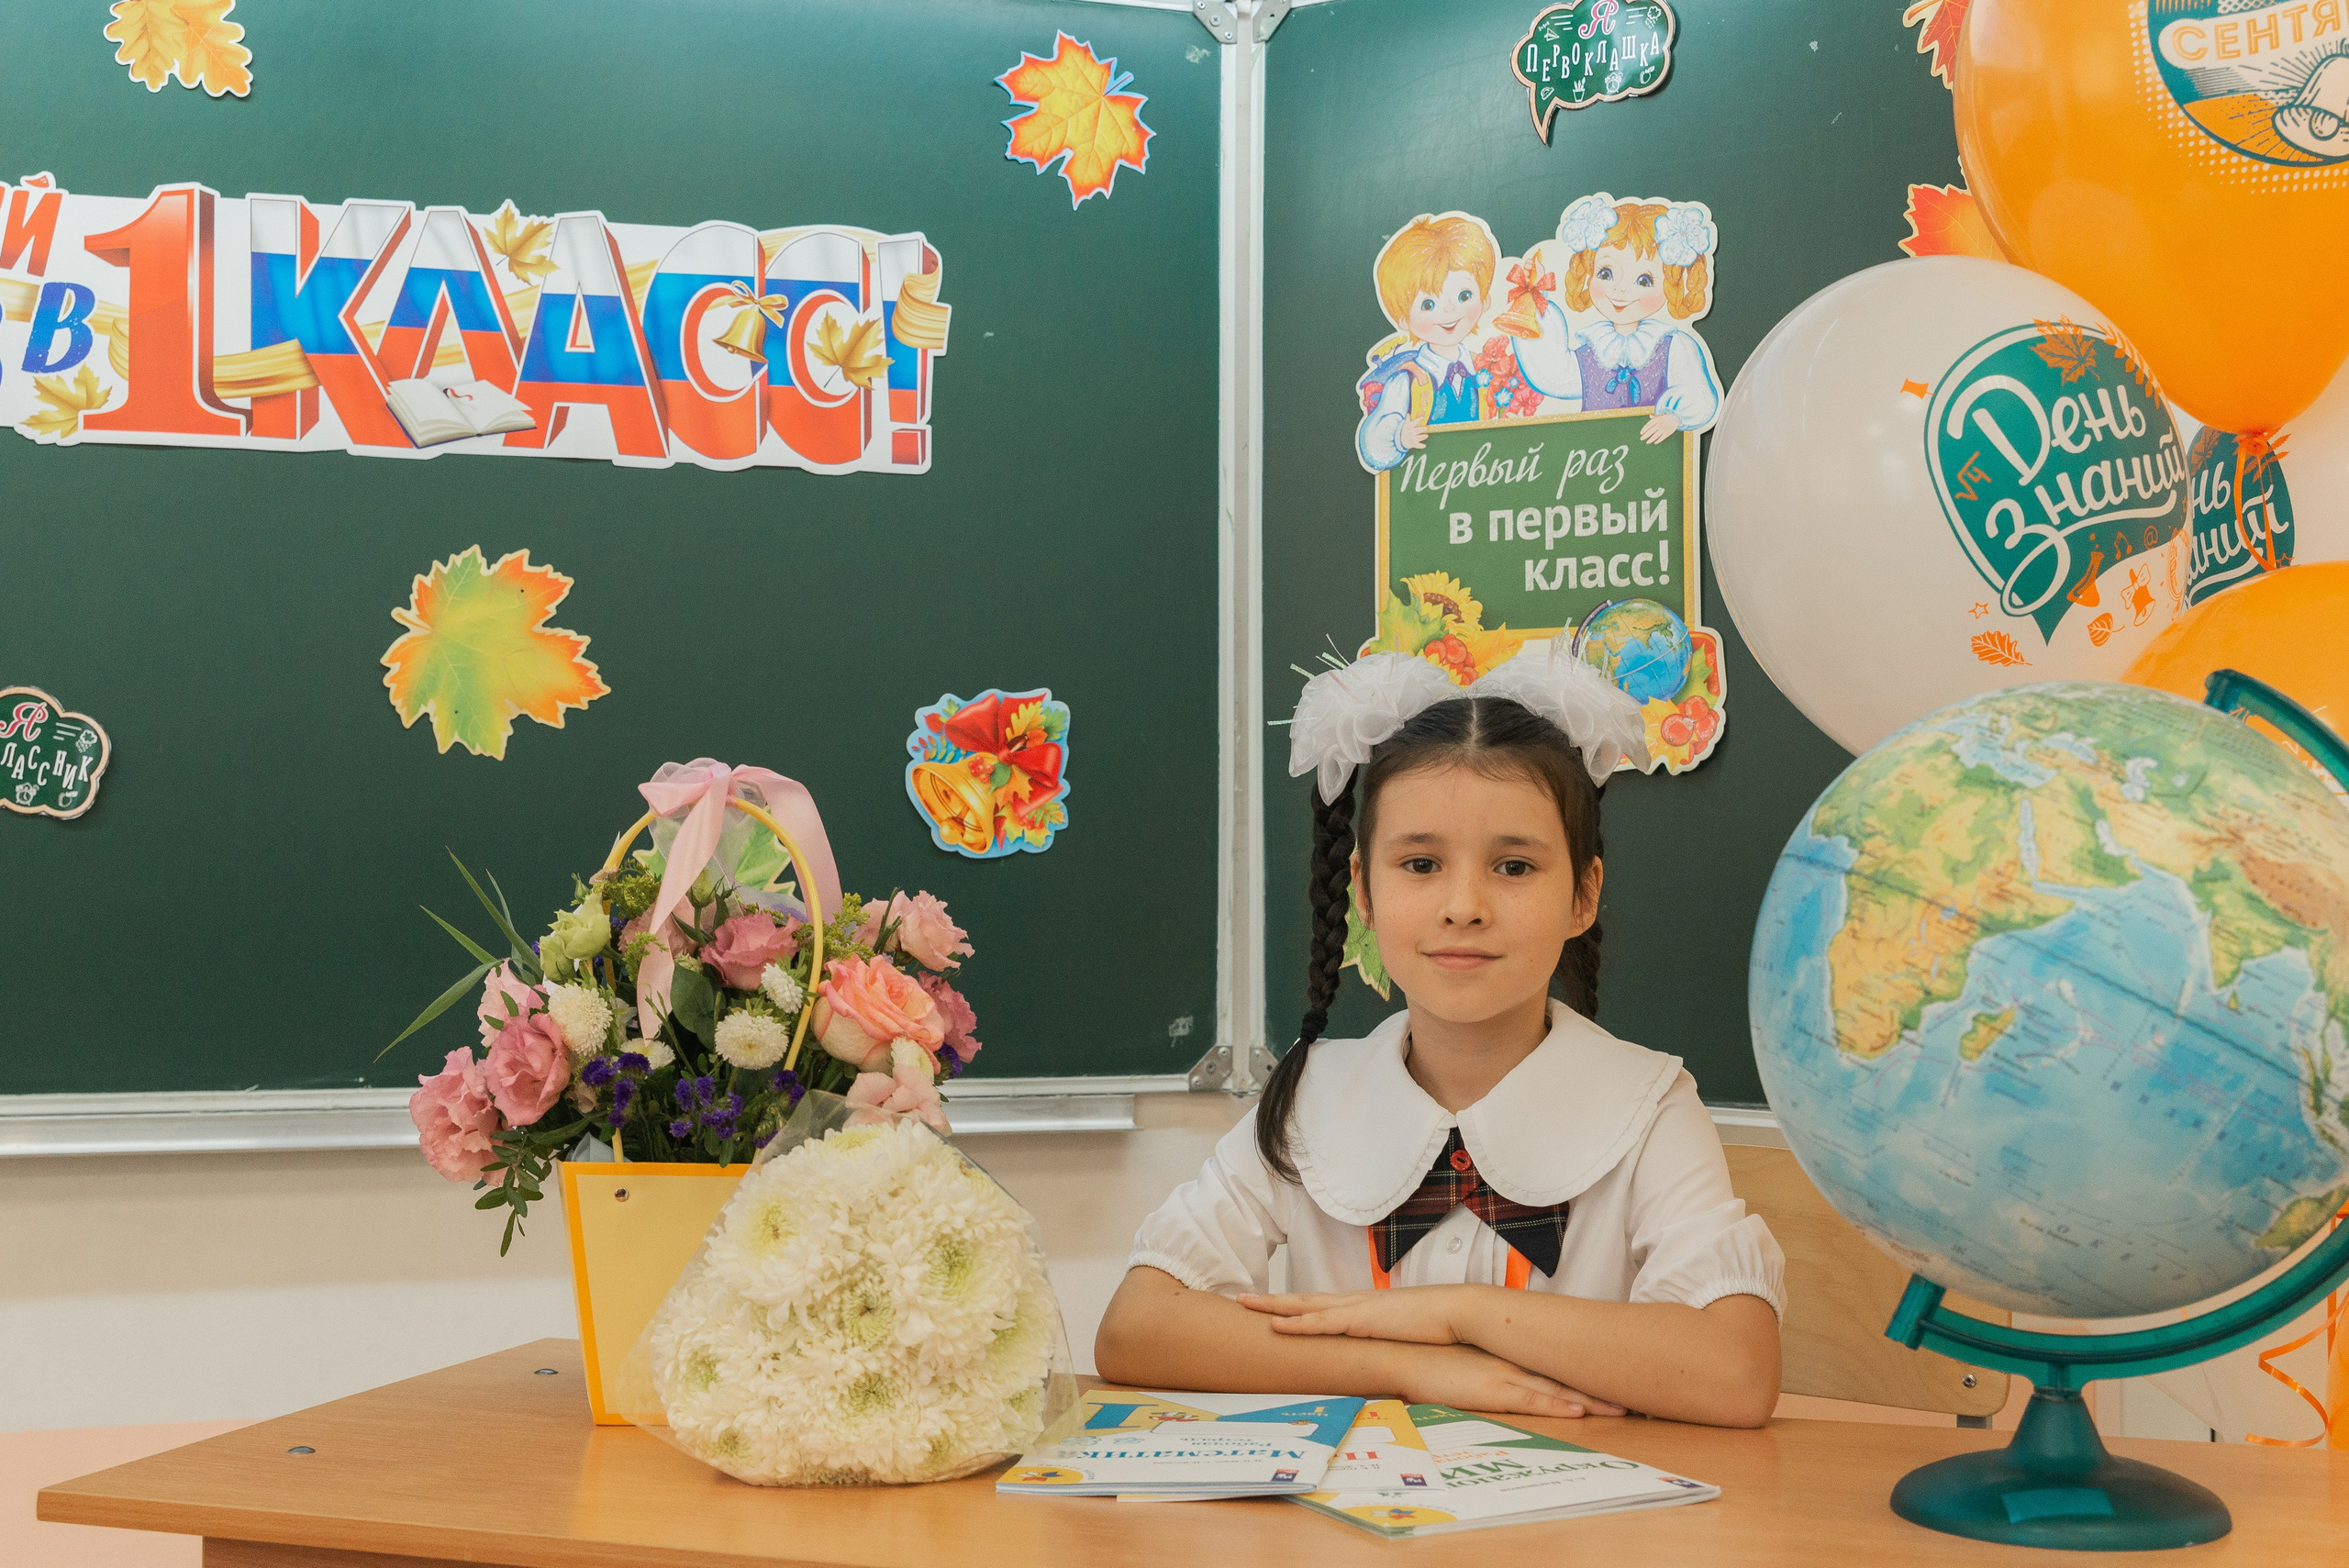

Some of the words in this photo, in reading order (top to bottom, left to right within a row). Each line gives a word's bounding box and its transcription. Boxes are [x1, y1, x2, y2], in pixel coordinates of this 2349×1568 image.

[1578, 0, 1620, 40] Я
[2171, 0, 2349, 61] СЕНТЯ
[1525, 31, 1660, 83] ПЕРВОКЛАШКА
[0, 175, 62, 277] Й
[83, 188, 252, 437] 1
[250, 196, 930, 466] КЛАСС!
[1947, 374, 2146, 487] День
[1400, 441, 1545, 510] Первый
[1556, 445, 1630, 499] раз
[2192, 461, 2232, 519] нь
[1449, 511, 1474, 544] в
[1489, 486, 1669, 550] первый
[1985, 428, 2185, 616] Знаний
[1524, 539, 1670, 592] класс!
[0, 701, 50, 742] Я
[1058, 1449, 1306, 1462] Математика
[1445, 1460, 1640, 1490] Окружаю
